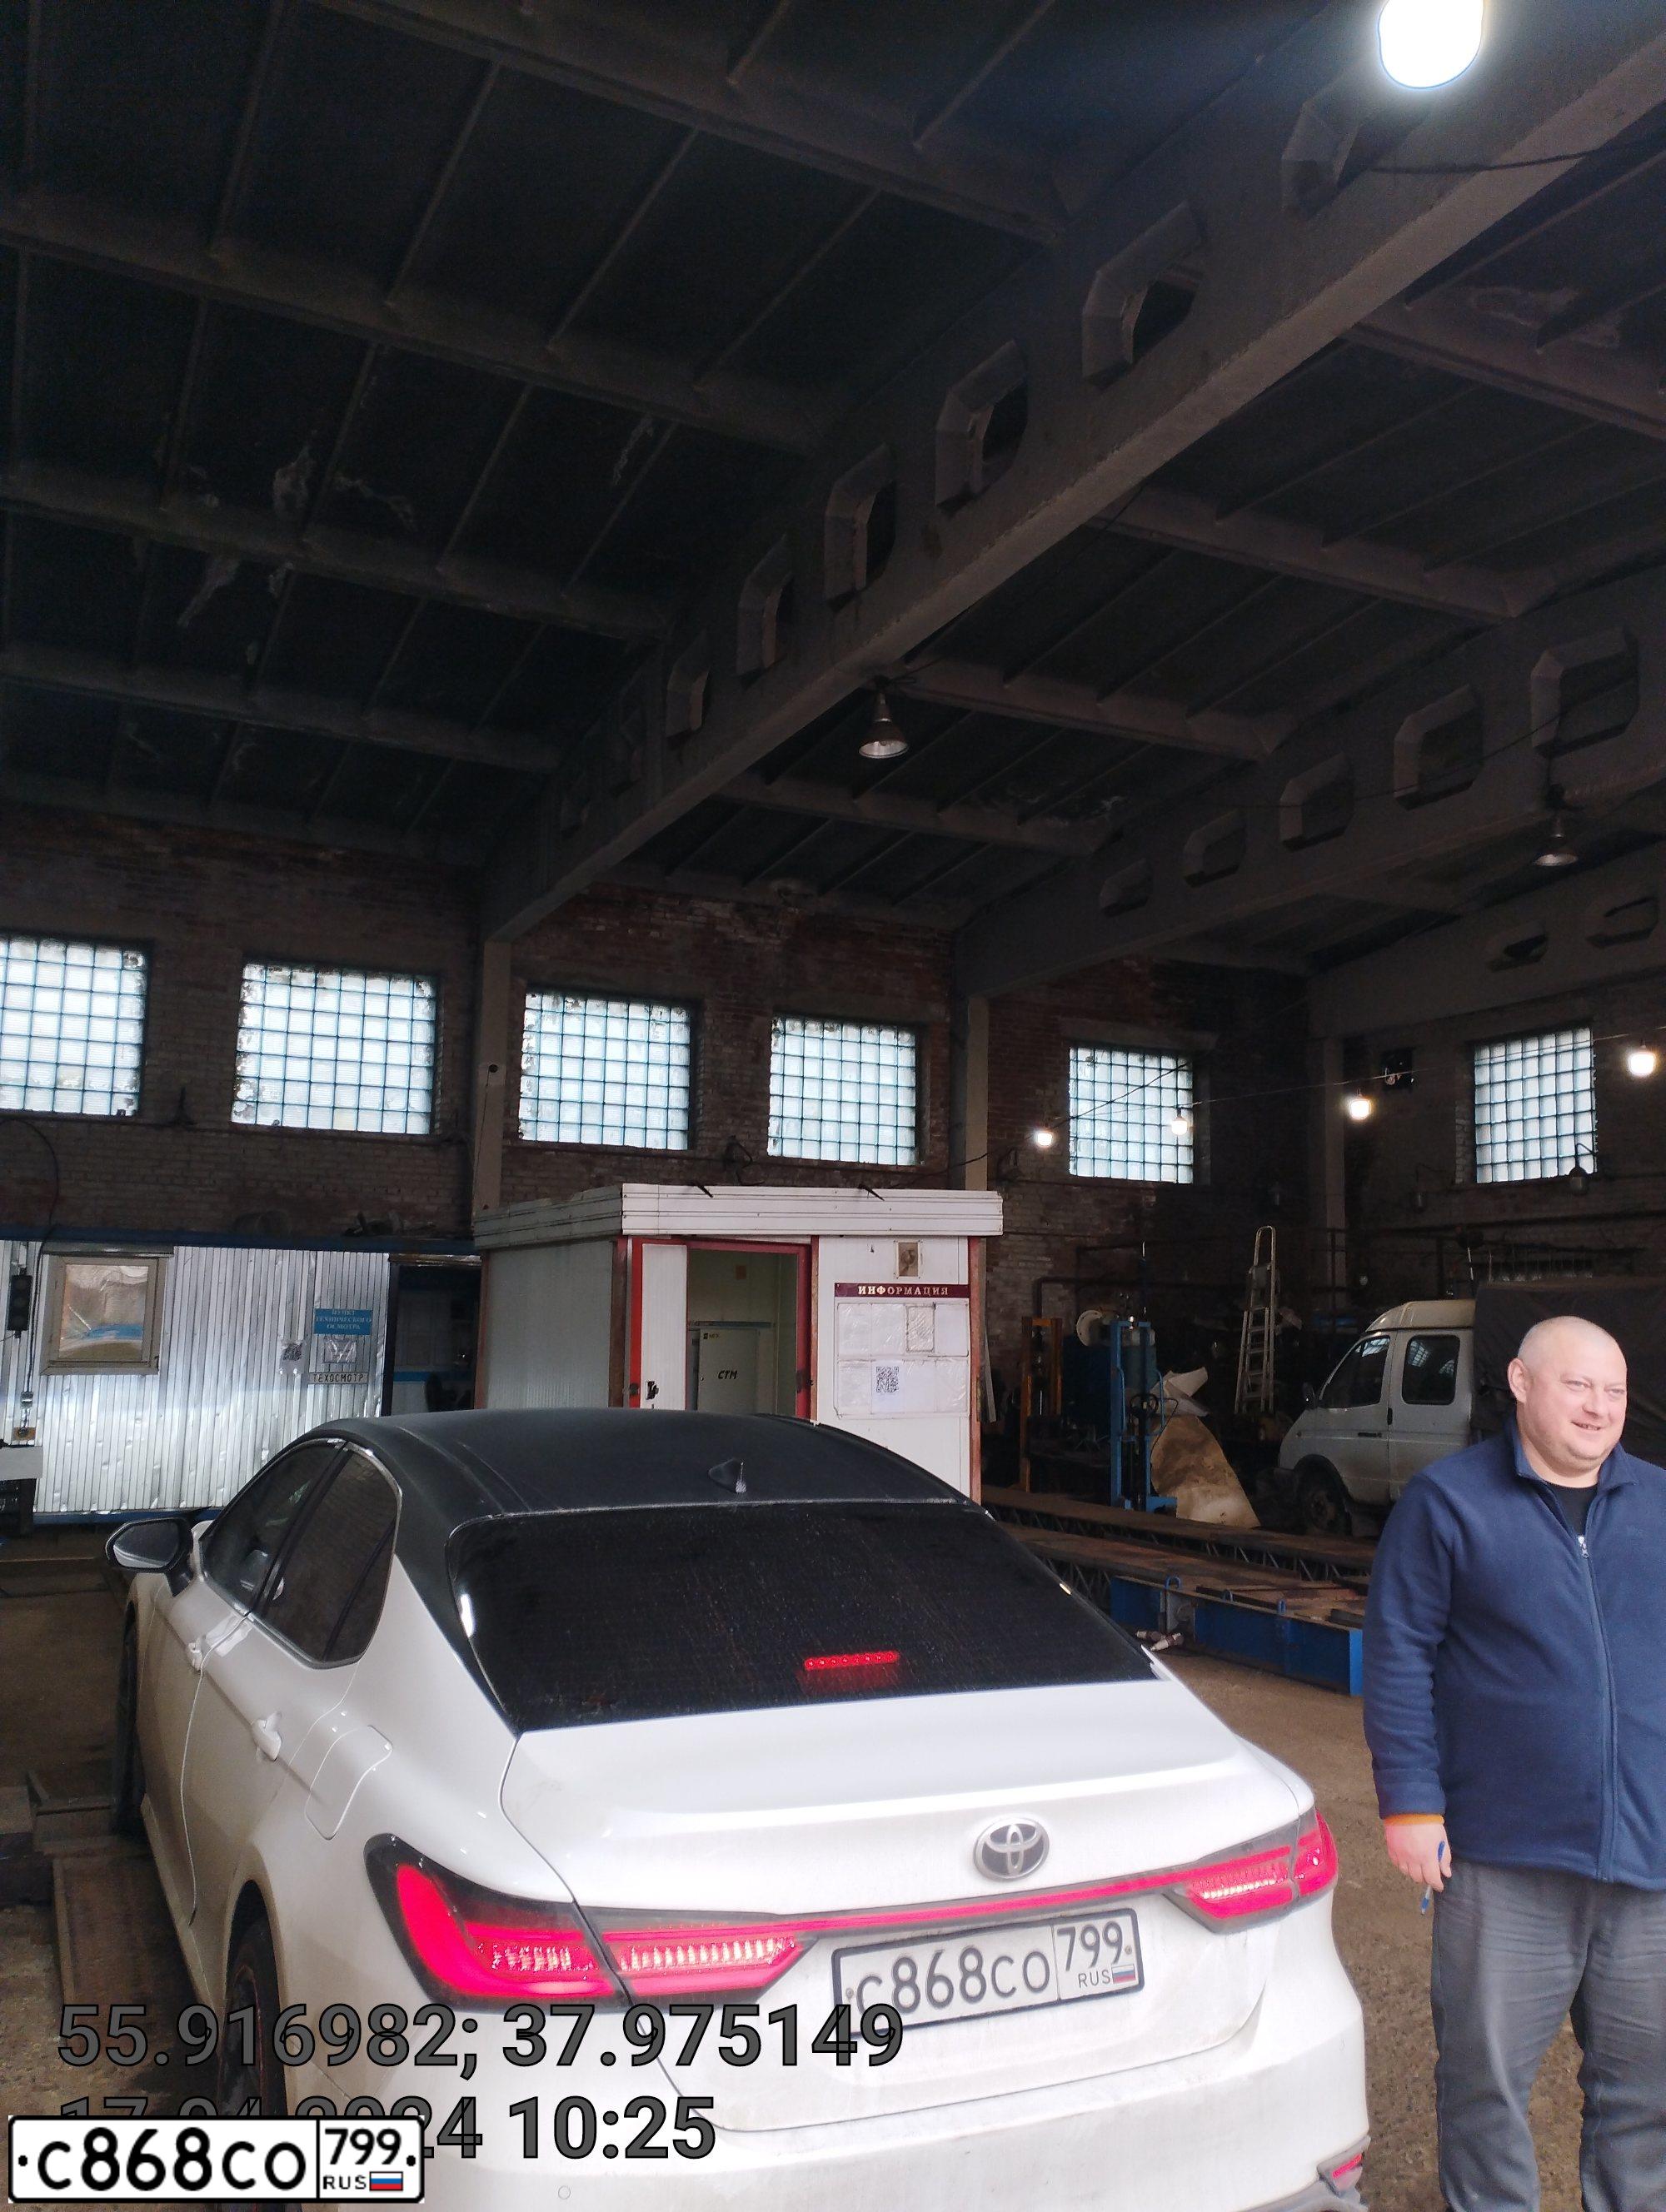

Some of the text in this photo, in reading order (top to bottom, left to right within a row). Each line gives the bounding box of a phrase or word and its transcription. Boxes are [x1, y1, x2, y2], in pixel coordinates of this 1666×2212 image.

[857, 1285, 949, 1297] ИНФОРМАЦИЯ
[313, 1373, 364, 1382] ТЕХОСМОТР
[1056, 1920, 1124, 1973] 799
[1078, 1969, 1112, 1990] RUS
